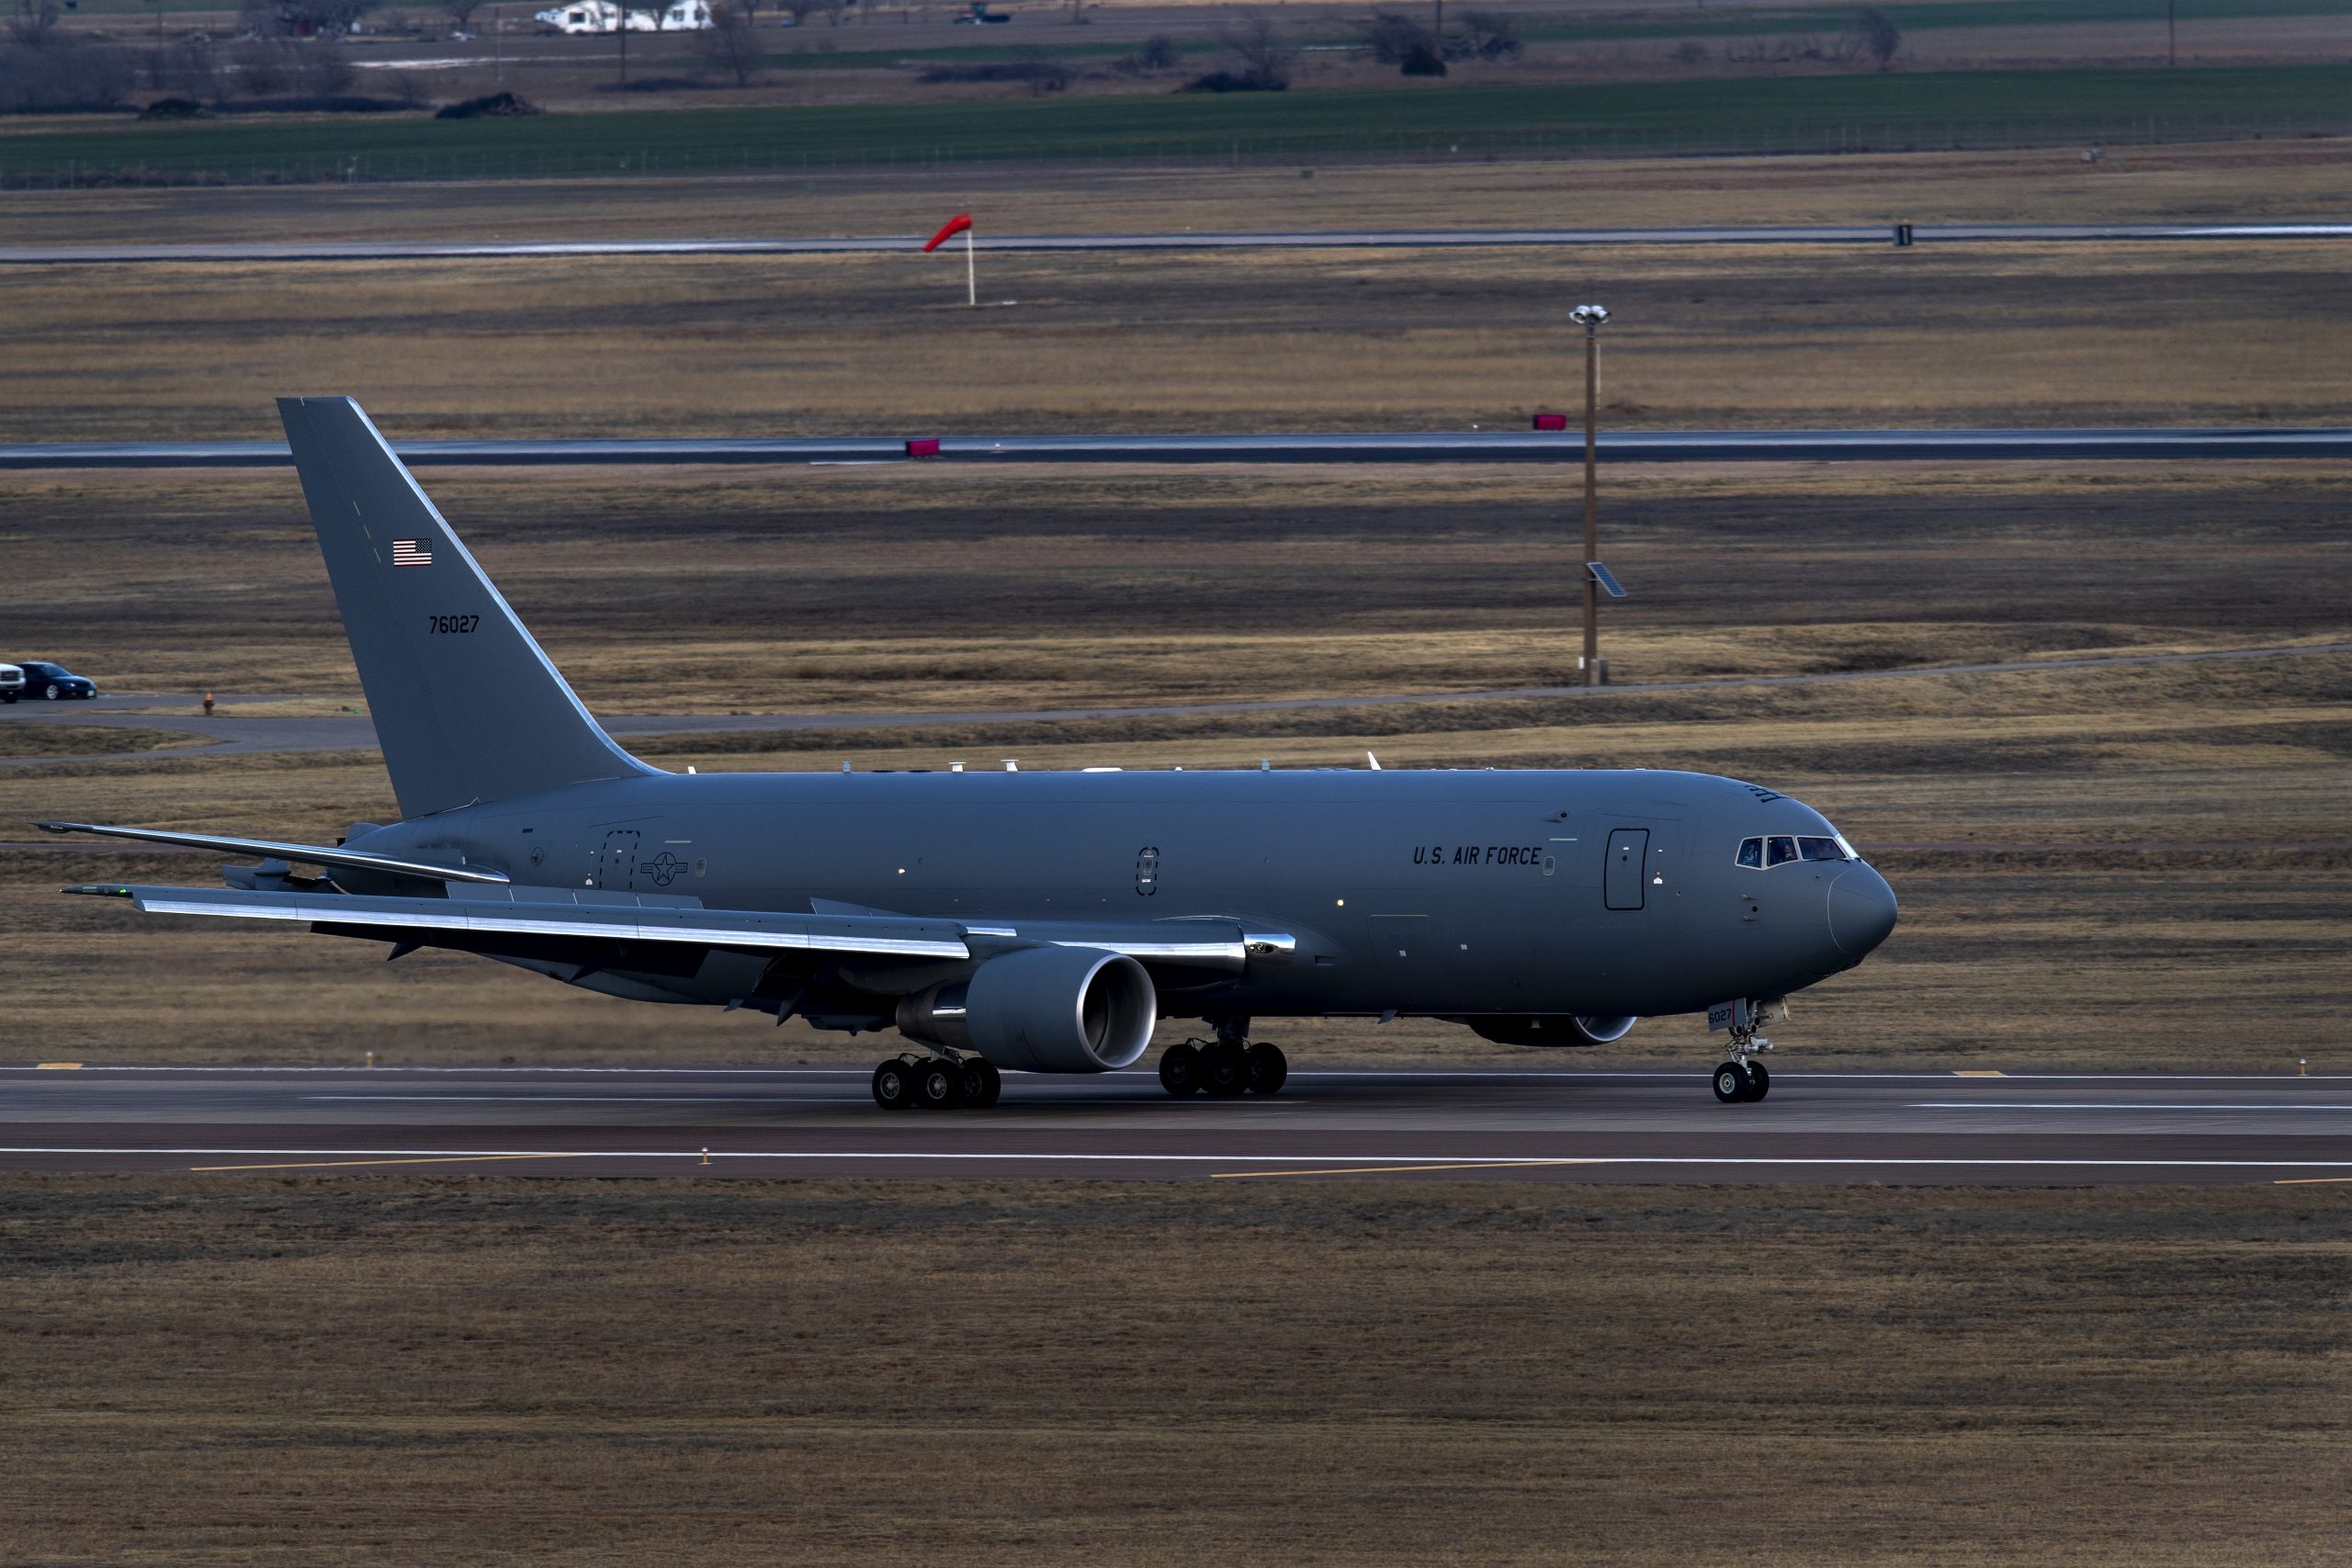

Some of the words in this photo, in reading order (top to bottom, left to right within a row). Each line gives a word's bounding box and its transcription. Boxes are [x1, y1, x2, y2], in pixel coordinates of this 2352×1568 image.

[429, 615, 480, 634] 76027
[1413, 846, 1445, 864] U.S.
[1453, 846, 1480, 864] AIR
[1486, 847, 1543, 864] FORCE
[1708, 1009, 1732, 1023] 6027
